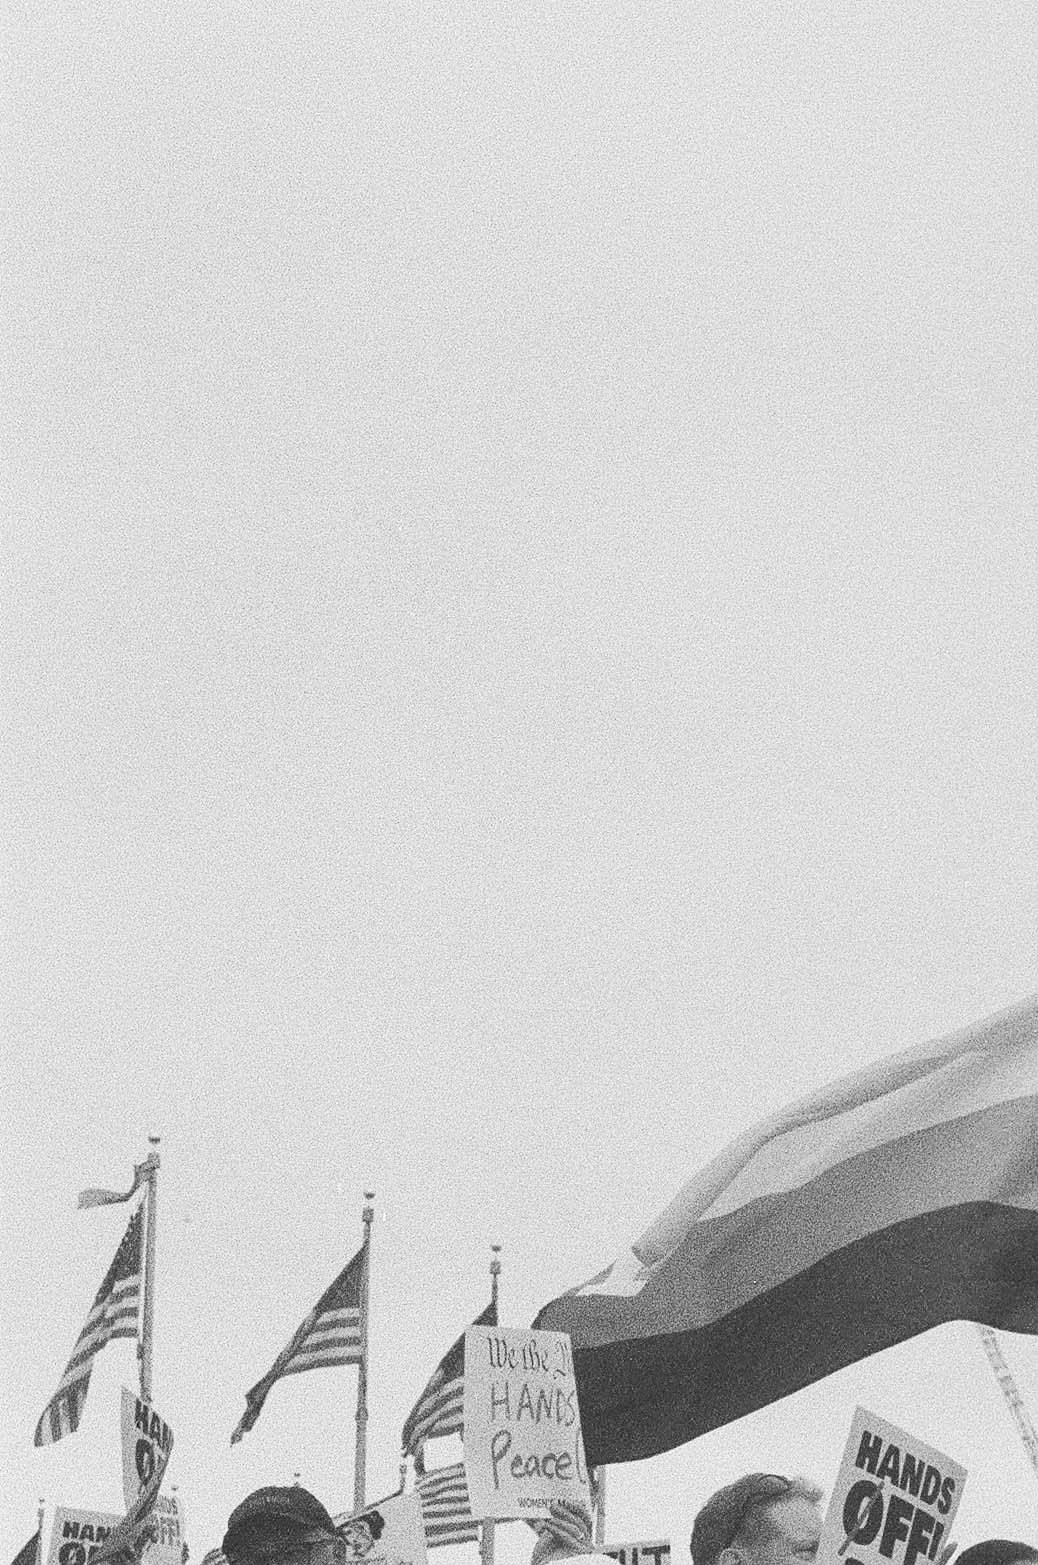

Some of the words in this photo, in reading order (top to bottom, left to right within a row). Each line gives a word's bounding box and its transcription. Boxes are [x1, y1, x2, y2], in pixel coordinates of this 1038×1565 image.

[487, 1337, 519, 1369] We
[523, 1339, 549, 1371] the
[491, 1382, 576, 1427] HANDS
[855, 1430, 956, 1515] HANDS
[62, 1521, 111, 1543] HAN
